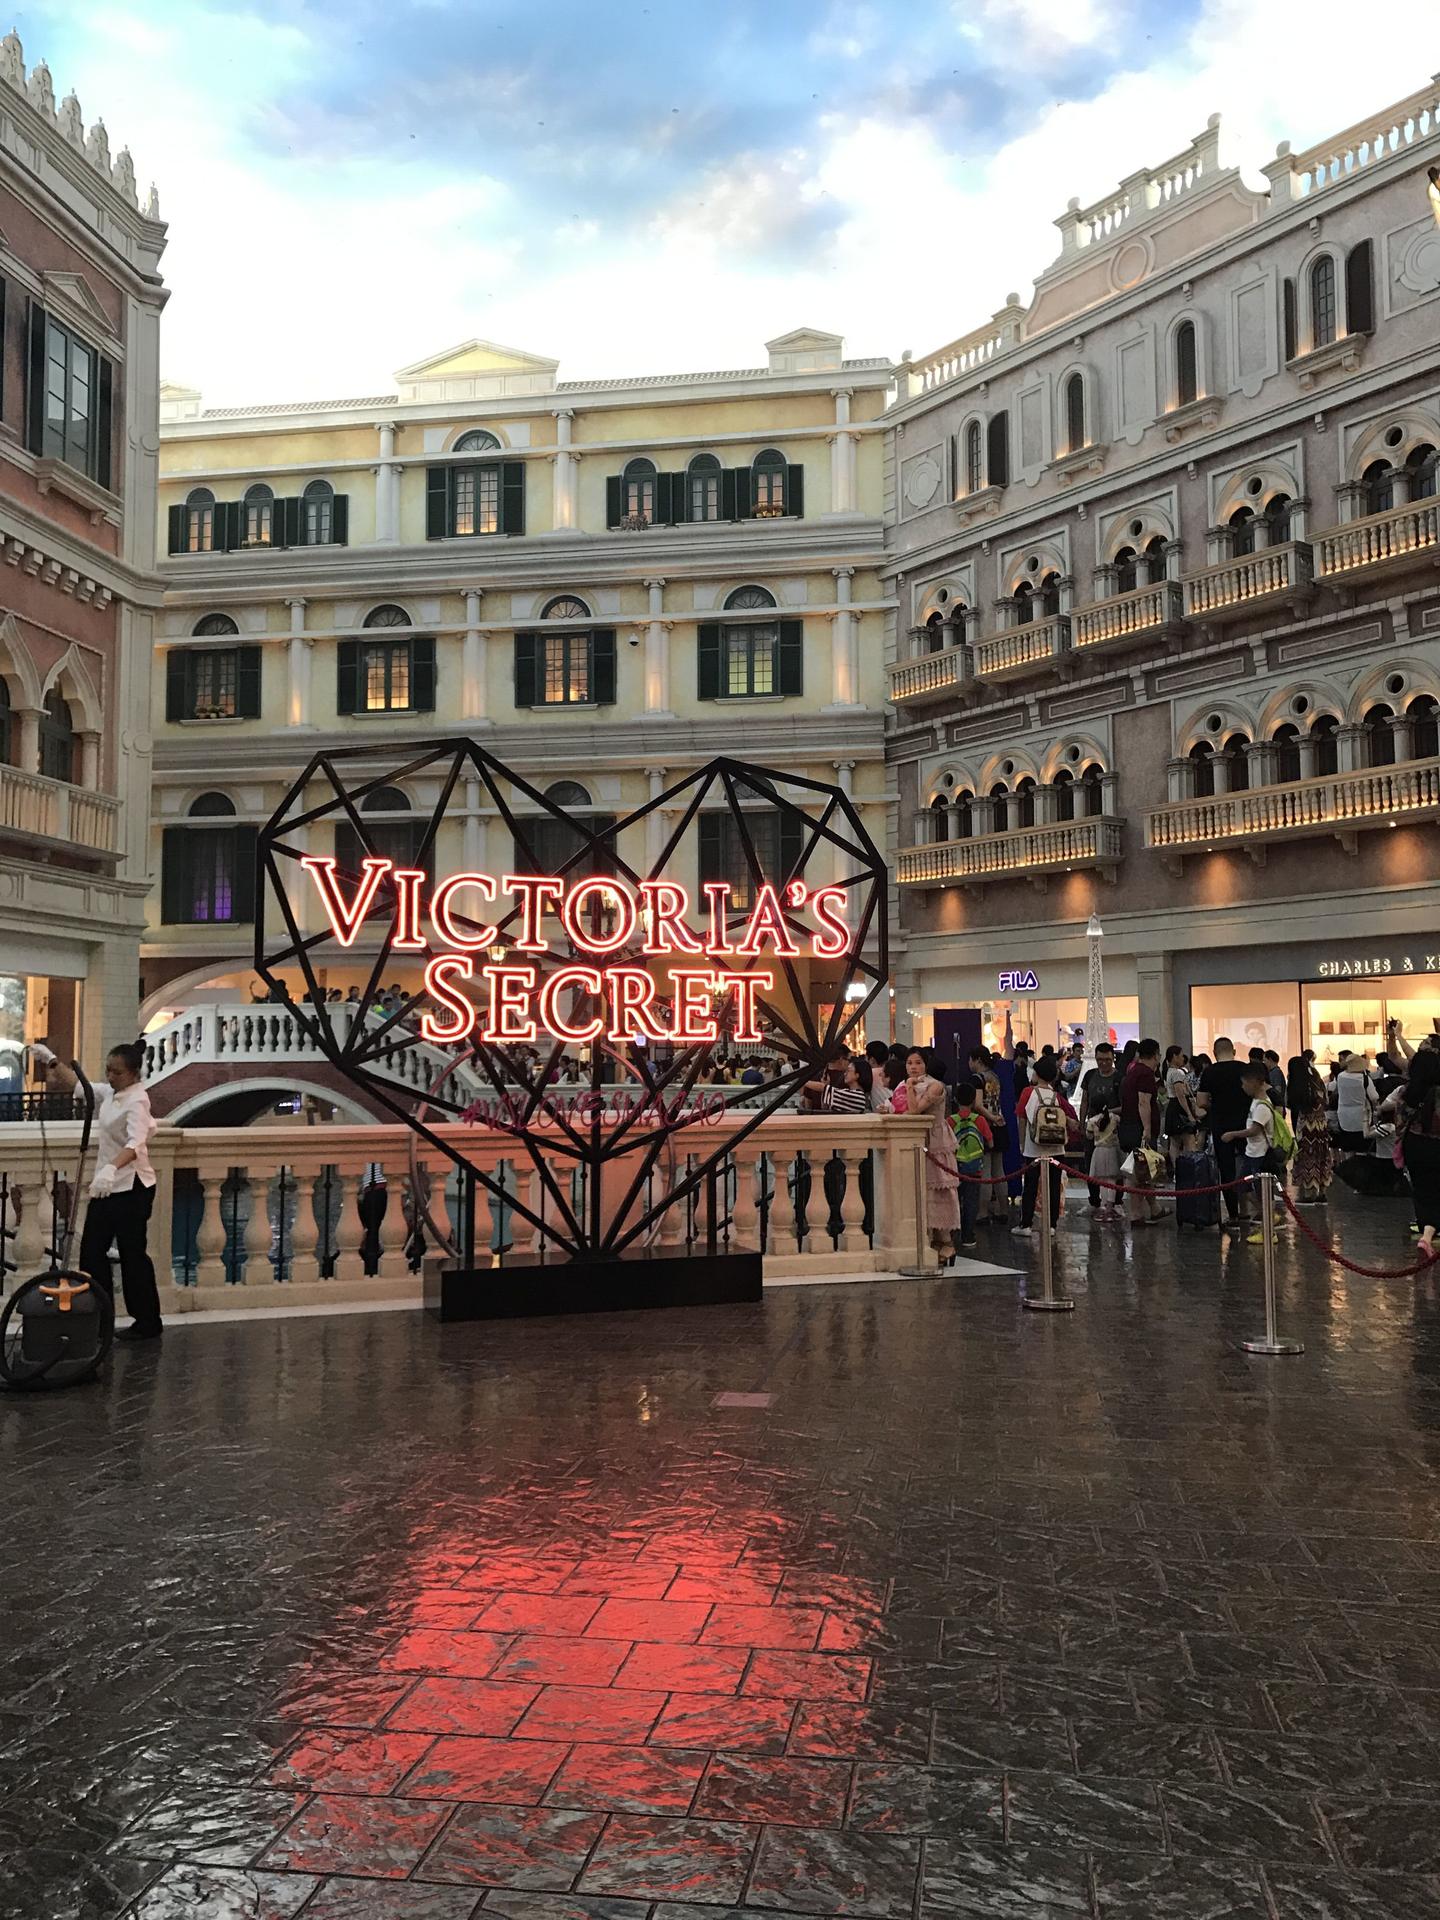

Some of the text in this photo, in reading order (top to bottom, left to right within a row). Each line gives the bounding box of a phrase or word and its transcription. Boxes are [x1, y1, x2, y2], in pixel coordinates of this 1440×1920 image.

[300, 856, 851, 959] VICTORIA'S
[998, 970, 1039, 991] FILA
[1319, 954, 1440, 977] CHARLES & K
[421, 954, 774, 1043] SECRET
